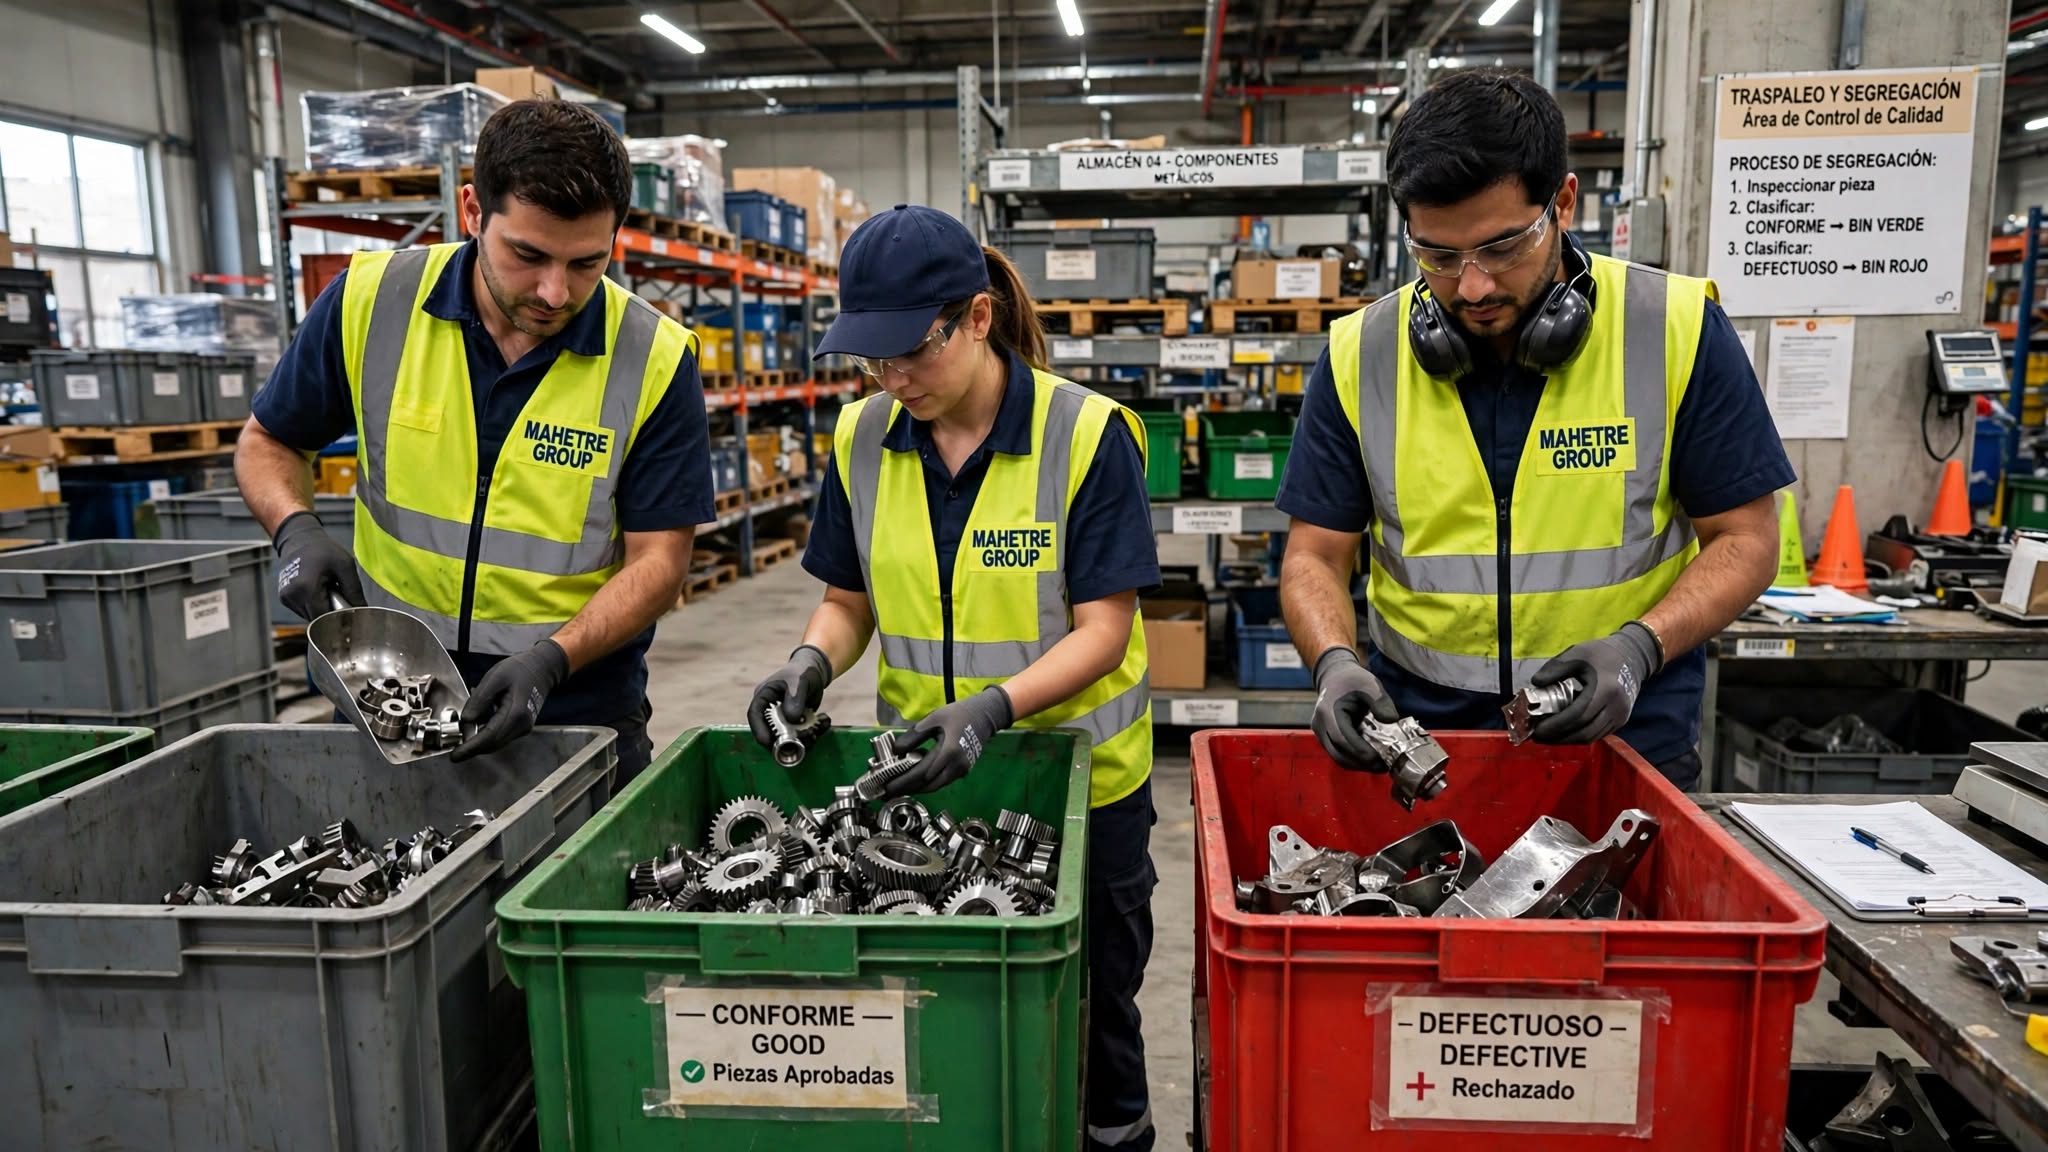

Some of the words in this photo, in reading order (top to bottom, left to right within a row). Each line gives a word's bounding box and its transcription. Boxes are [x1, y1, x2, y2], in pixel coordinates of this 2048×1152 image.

[1730, 86, 1825, 105] TRASPALEO
[1829, 85, 1840, 102] Y
[1844, 78, 1961, 102] SEGREGACIÓN
[1743, 107, 1777, 128] Área
[1782, 110, 1800, 126] de
[1804, 108, 1860, 126] Control
[1864, 108, 1882, 124] de
[1887, 106, 1944, 124] Calidad
[1077, 151, 1141, 169] ALMACÉN
[1146, 155, 1161, 168] 04
[1175, 152, 1278, 168] COMPONENTES
[1730, 155, 1800, 172] PROCESO
[1803, 154, 1822, 169] DE
[1826, 149, 1937, 169] SEGREGACIÓN:
[1154, 169, 1214, 184] METÁLICOS
[1730, 180, 1742, 194] 1.
[1747, 178, 1836, 196] Inspeccionar
[1839, 178, 1875, 195] pieza
[1729, 201, 1741, 214] 2.
[1746, 199, 1815, 214] Clasificar:
[1745, 219, 1826, 235] CONFORME
[1848, 218, 1873, 233] BIN
[1877, 217, 1925, 232] VERDE
[1727, 242, 1739, 255] 3.
[1744, 241, 1813, 256] Clasificar:
[1743, 260, 1838, 277] DEFECTUOSO
[1861, 259, 1885, 274] BIN
[1889, 258, 1928, 274] ROJO
[524, 420, 609, 454] MAHETRE
[1540, 425, 1629, 449] MAHETRE
[533, 443, 593, 470] GROUP
[1552, 447, 1617, 470] GROUP
[972, 529, 1051, 548] MAHETRE
[982, 549, 1040, 567] GROUP
[712, 1003, 856, 1027] CONFORME
[1419, 1011, 1603, 1037] DEFECTUOSO
[751, 1033, 826, 1055] GOOD
[1440, 1043, 1587, 1069] DEFECTIVE
[713, 1063, 778, 1083] Piezas
[784, 1064, 895, 1088] Aprobadas
[1452, 1077, 1575, 1101] Rechazado
